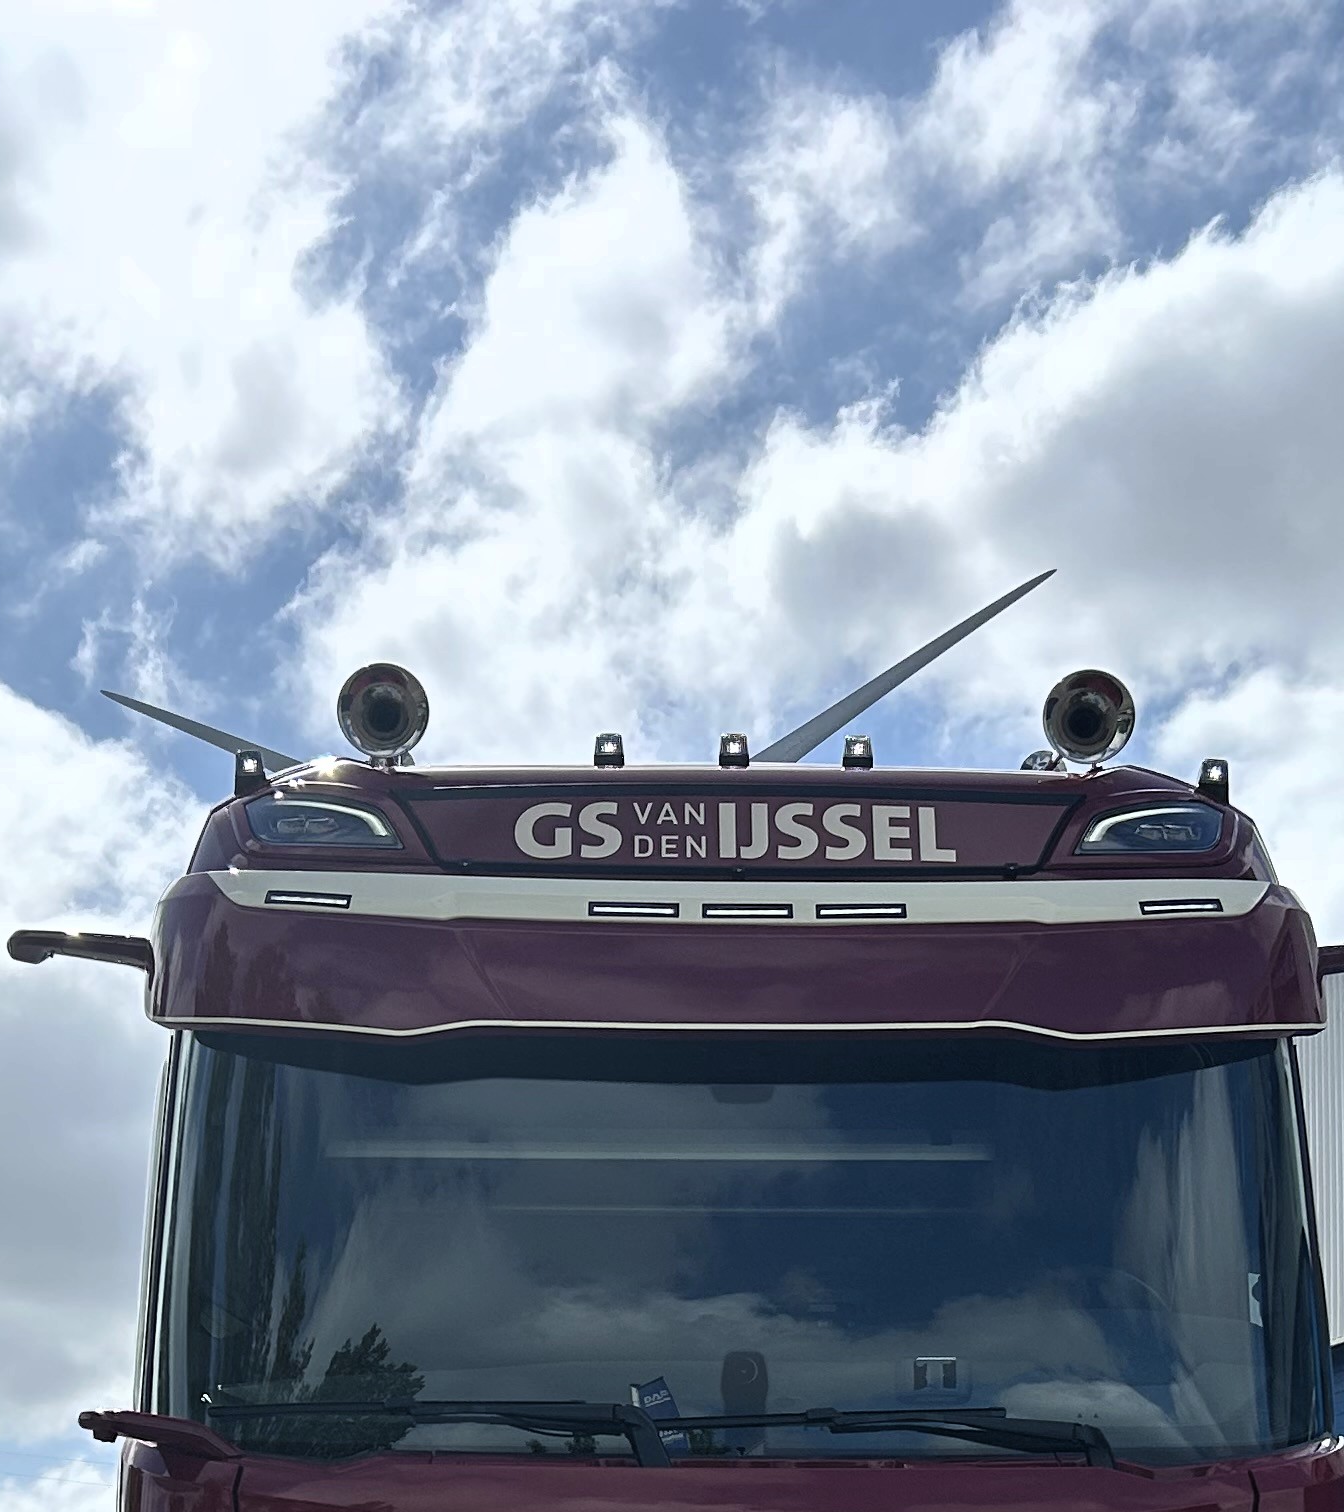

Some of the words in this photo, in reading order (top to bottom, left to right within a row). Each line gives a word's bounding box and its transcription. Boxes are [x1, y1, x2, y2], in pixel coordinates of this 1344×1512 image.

[514, 801, 623, 860] GS
[633, 802, 705, 825] VAN
[718, 802, 957, 863] IJSSEL
[634, 835, 707, 859] DEN
